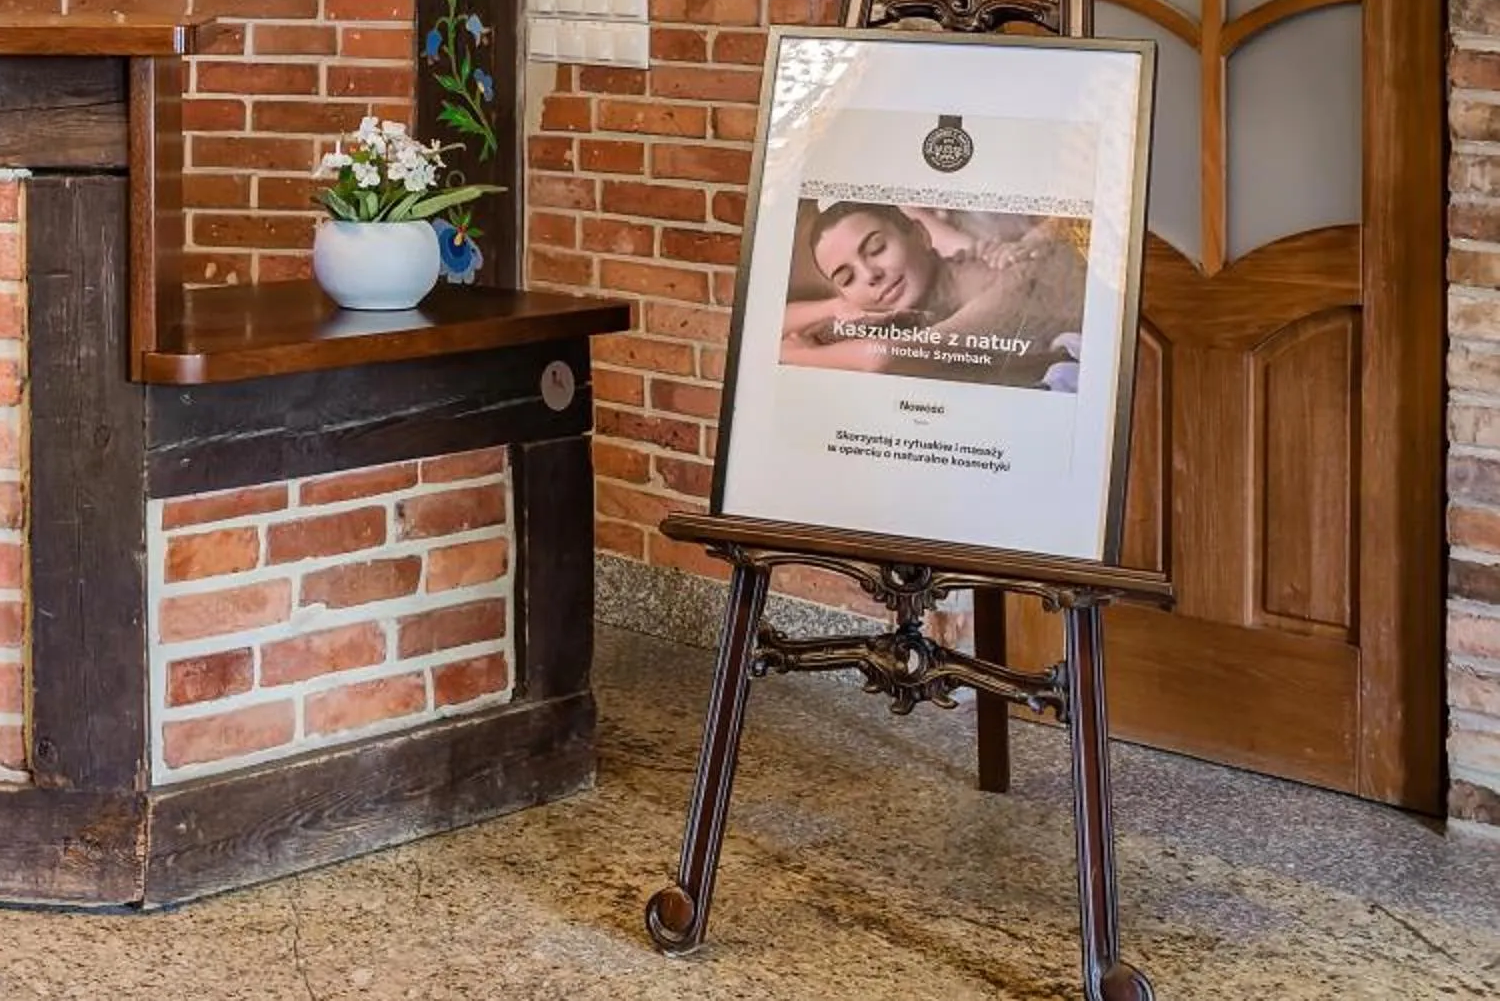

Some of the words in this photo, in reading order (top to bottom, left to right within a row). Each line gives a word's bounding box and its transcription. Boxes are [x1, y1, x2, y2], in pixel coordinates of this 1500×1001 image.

[833, 319, 941, 345] Kaszubskie
[948, 333, 959, 347] z
[965, 333, 1032, 357] natury
[933, 349, 993, 366] Szymbark
[884, 450, 892, 458] o
